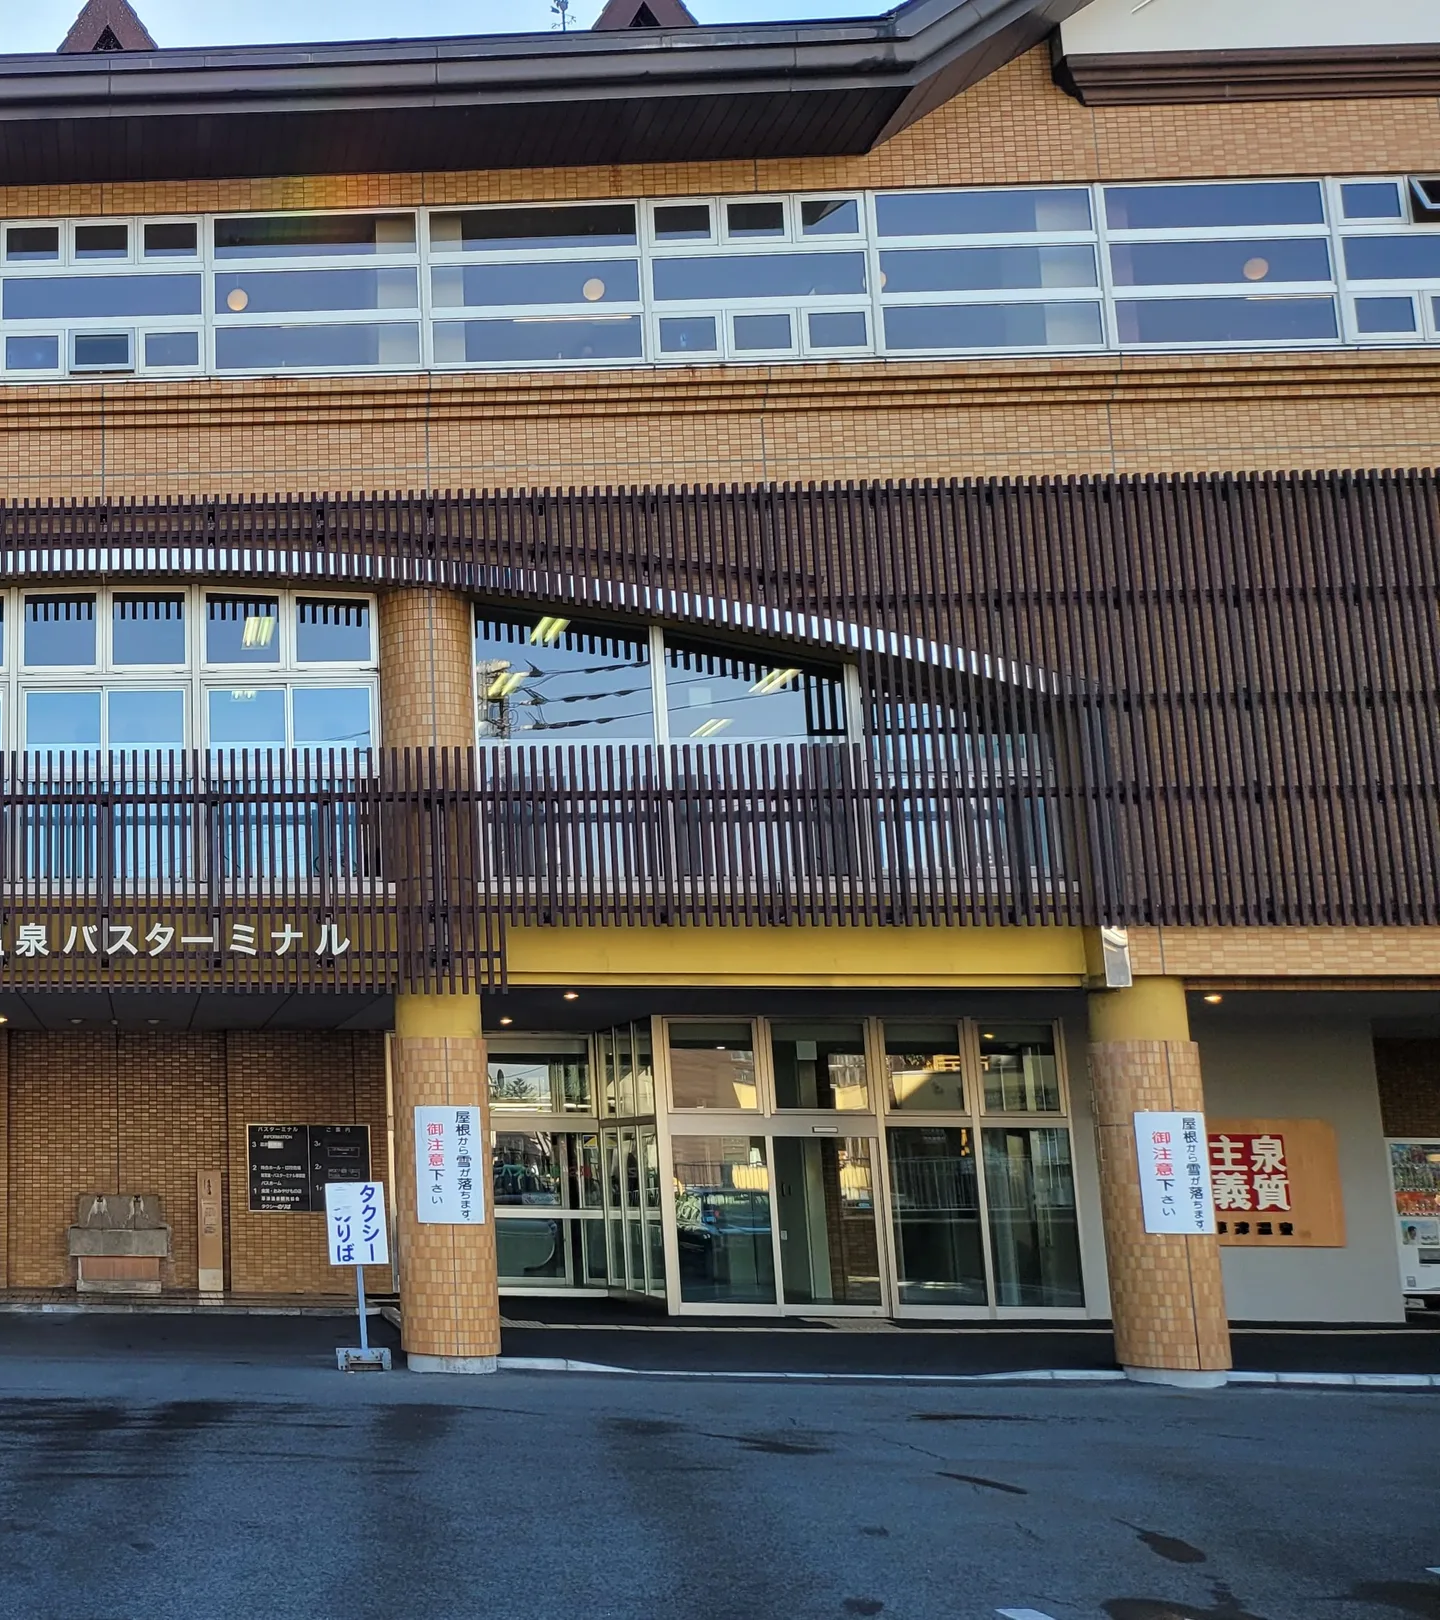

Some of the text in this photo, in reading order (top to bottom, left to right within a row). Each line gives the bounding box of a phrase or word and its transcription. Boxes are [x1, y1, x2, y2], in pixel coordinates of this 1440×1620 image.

[426, 1122, 446, 1205] 御注意下さい
[1151, 1131, 1176, 1217] 御注意下さい
[1208, 1134, 1253, 1211] 主義
[1250, 1135, 1292, 1211] 泉質
[333, 1208, 355, 1262] りば
[360, 1184, 380, 1262] タクシー
